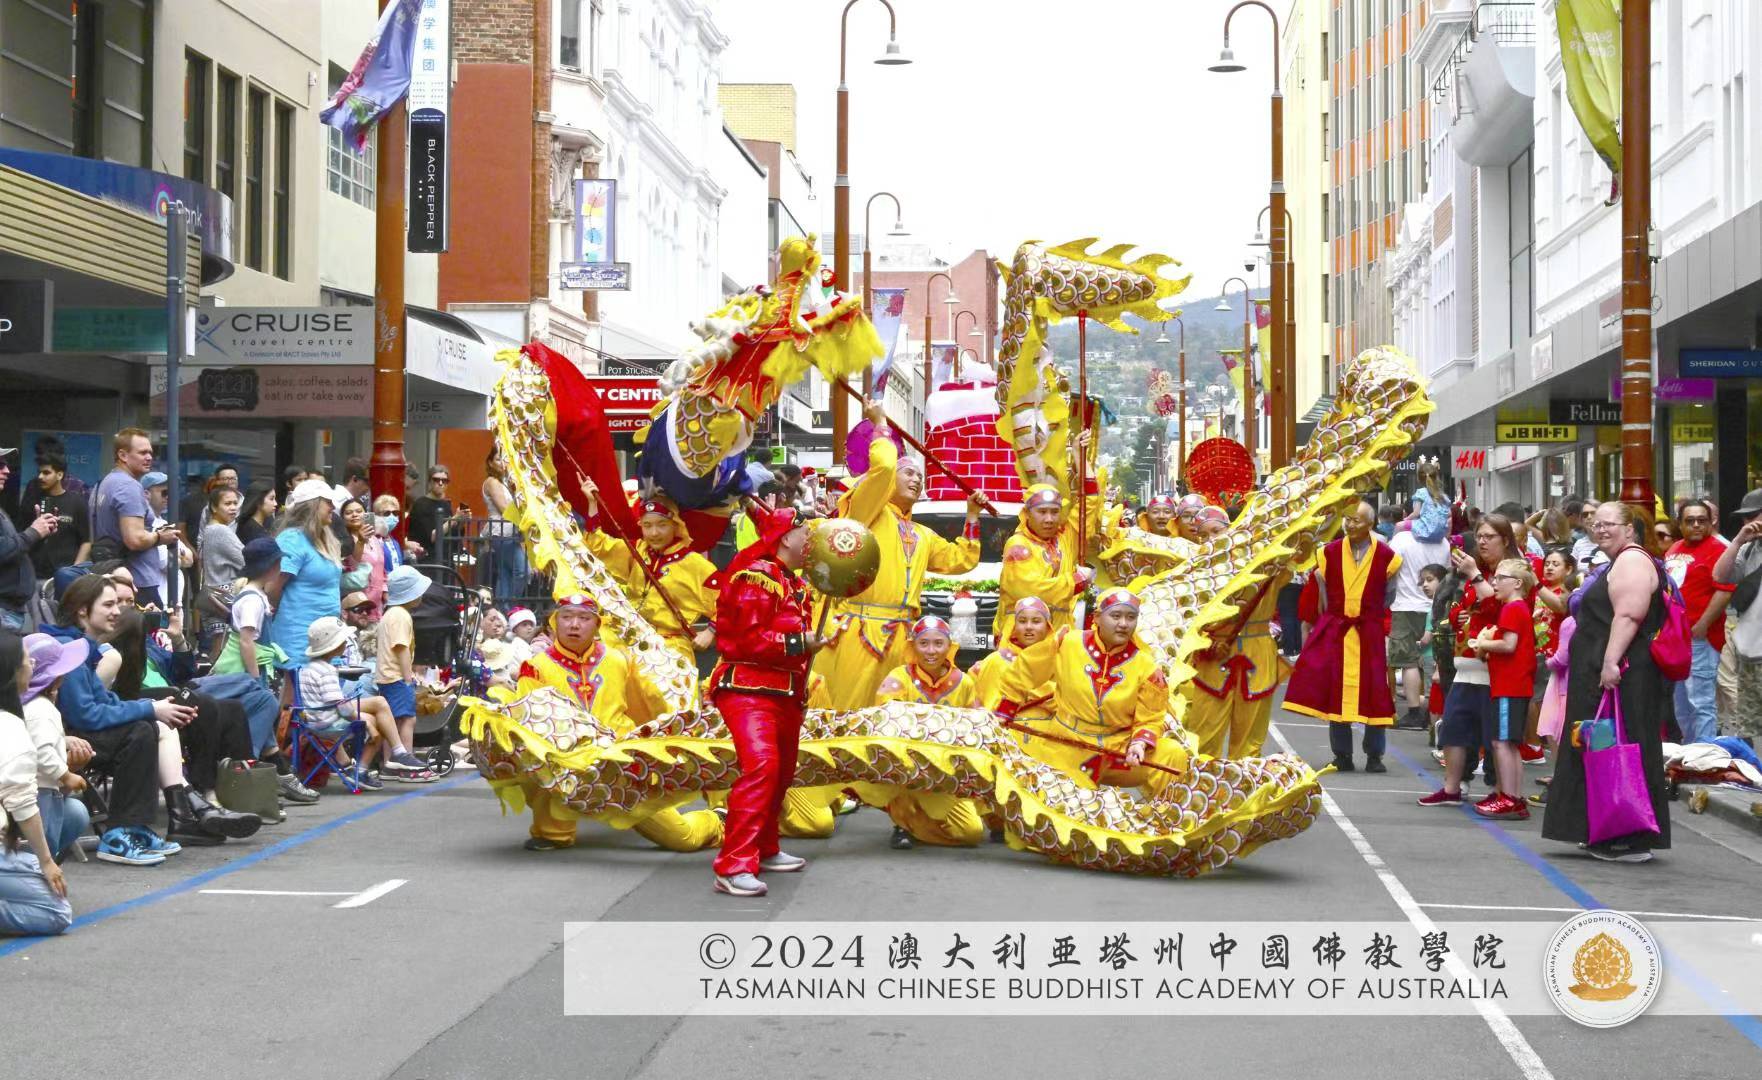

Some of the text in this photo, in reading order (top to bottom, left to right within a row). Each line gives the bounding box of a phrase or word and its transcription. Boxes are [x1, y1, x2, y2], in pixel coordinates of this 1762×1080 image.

[426, 139, 436, 240] BLACK PEPPER
[231, 313, 353, 332] CRUISE
[232, 338, 286, 346] travel
[445, 338, 467, 360] CRUISE
[336, 376, 369, 387] salads
[264, 391, 366, 403] eat in or take away
[607, 388, 664, 401] CENTR
[408, 401, 443, 412] UISE
[608, 419, 633, 427] IGHT
[1505, 427, 1569, 438] JB HI-FI
